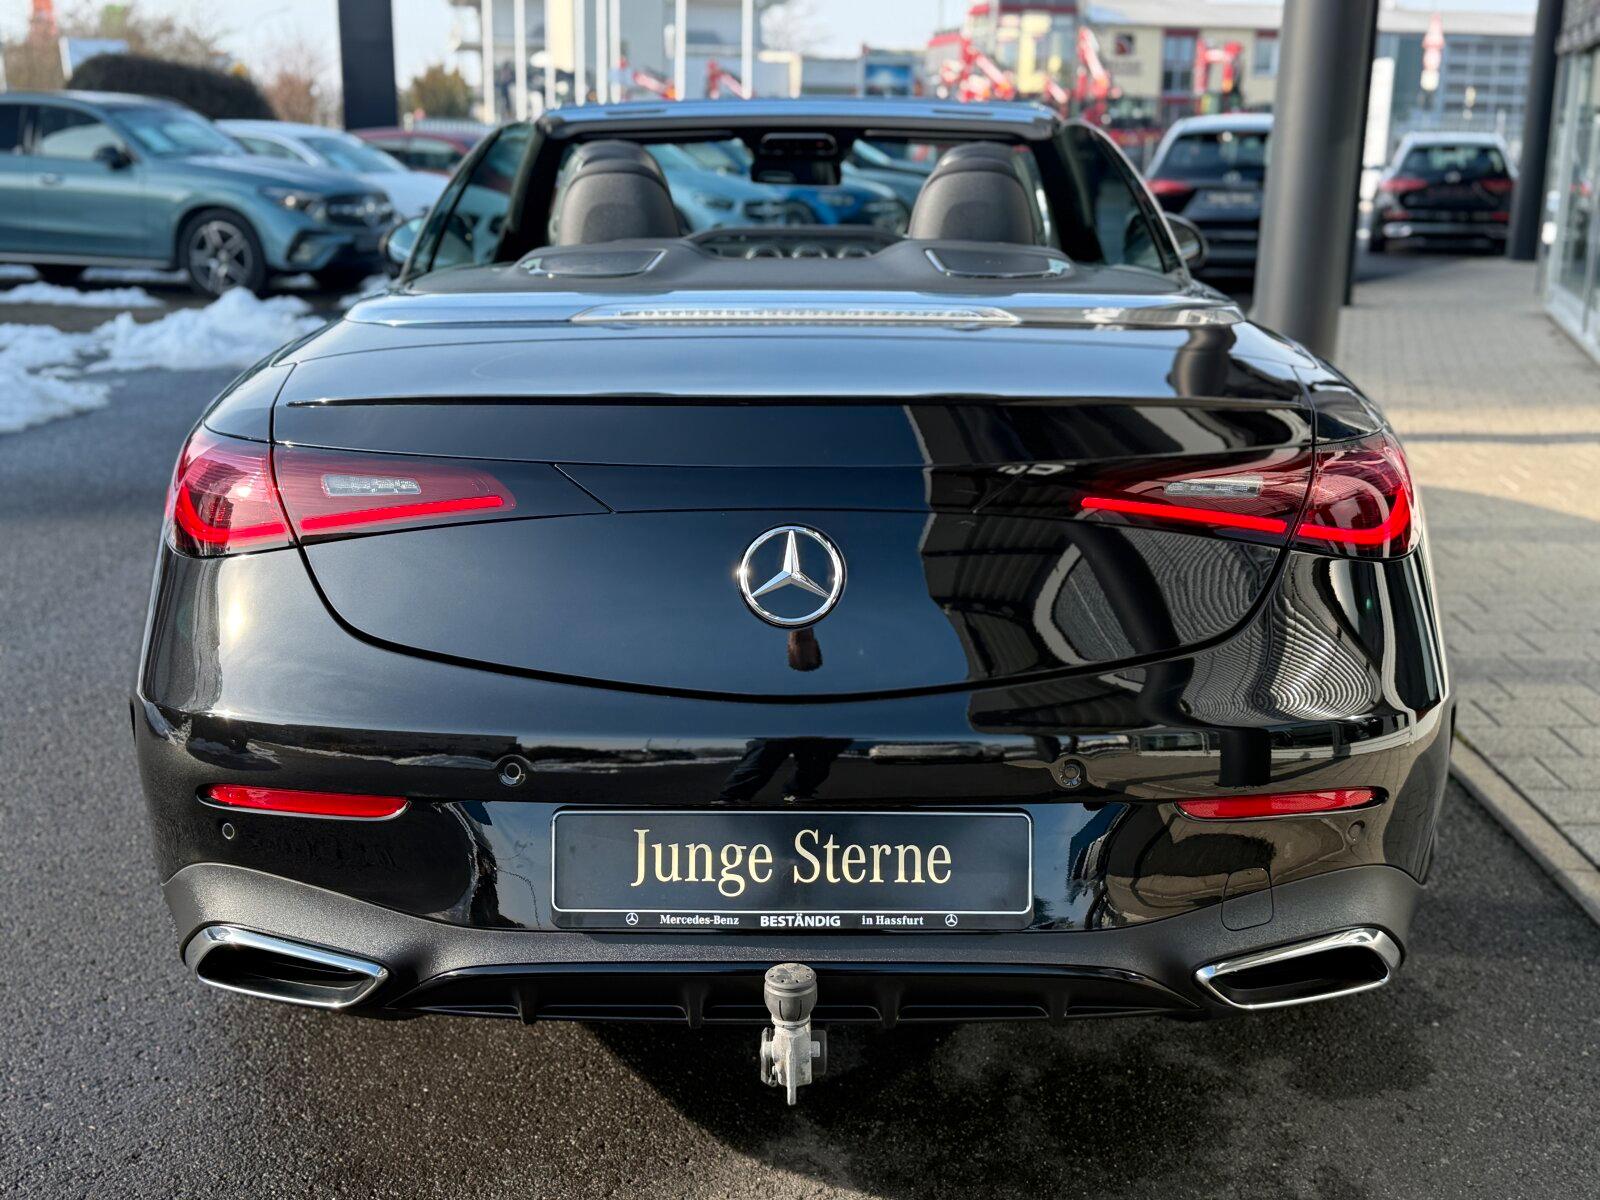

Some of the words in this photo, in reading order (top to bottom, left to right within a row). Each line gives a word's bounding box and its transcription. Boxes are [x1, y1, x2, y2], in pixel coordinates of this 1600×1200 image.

[631, 828, 774, 898] Junge
[793, 829, 952, 885] Sterne
[659, 914, 740, 927] Mercedes-Benz
[760, 913, 841, 928] BESTÄNDIG
[861, 914, 874, 926] in
[875, 914, 925, 926] Hassfurt
